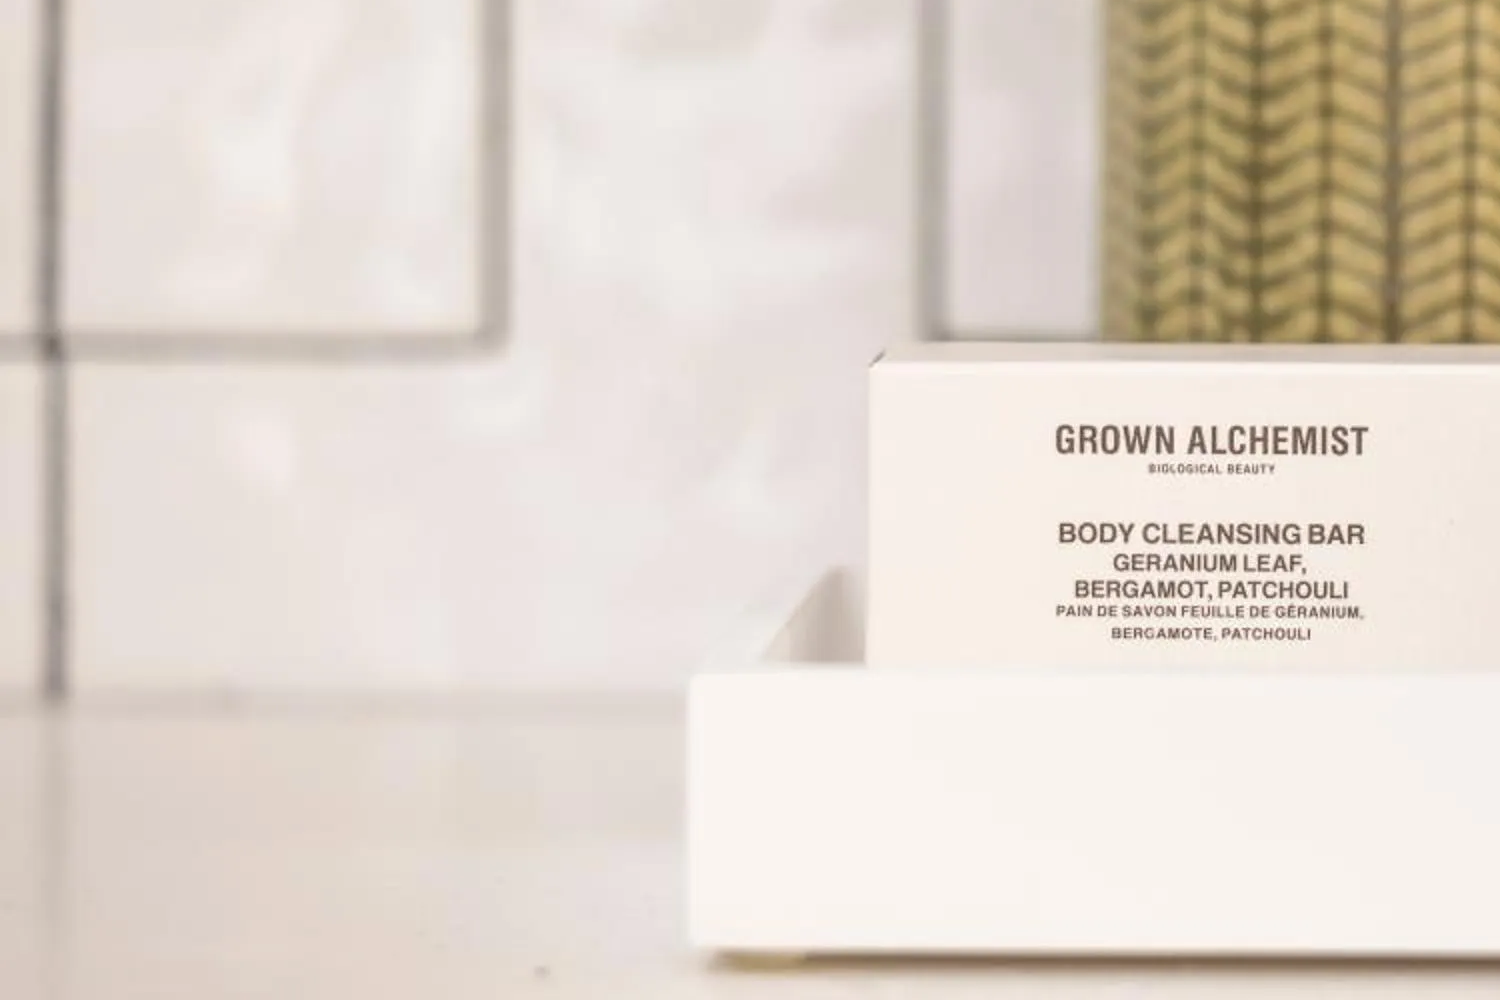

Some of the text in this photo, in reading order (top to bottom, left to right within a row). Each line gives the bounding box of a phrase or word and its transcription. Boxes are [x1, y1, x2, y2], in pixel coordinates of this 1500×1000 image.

[1054, 423, 1369, 456] GROWN ALCHEMIST
[1148, 463, 1276, 475] BIOLOGICAL BEAUTY
[1058, 522, 1366, 545] BODY CLEANSING BAR
[1112, 553, 1307, 575] GERANIUM LEAF,
[1074, 579, 1349, 602] BERGAMOT, PATCHOULI
[1055, 604, 1093, 618] PAIN
[1097, 604, 1117, 618] DE
[1121, 604, 1177, 618] SAVON
[1180, 604, 1245, 618] FEUILLE
[1249, 605, 1270, 618] DE
[1112, 627, 1312, 642] BERGAMOTE, PATCHOULI
